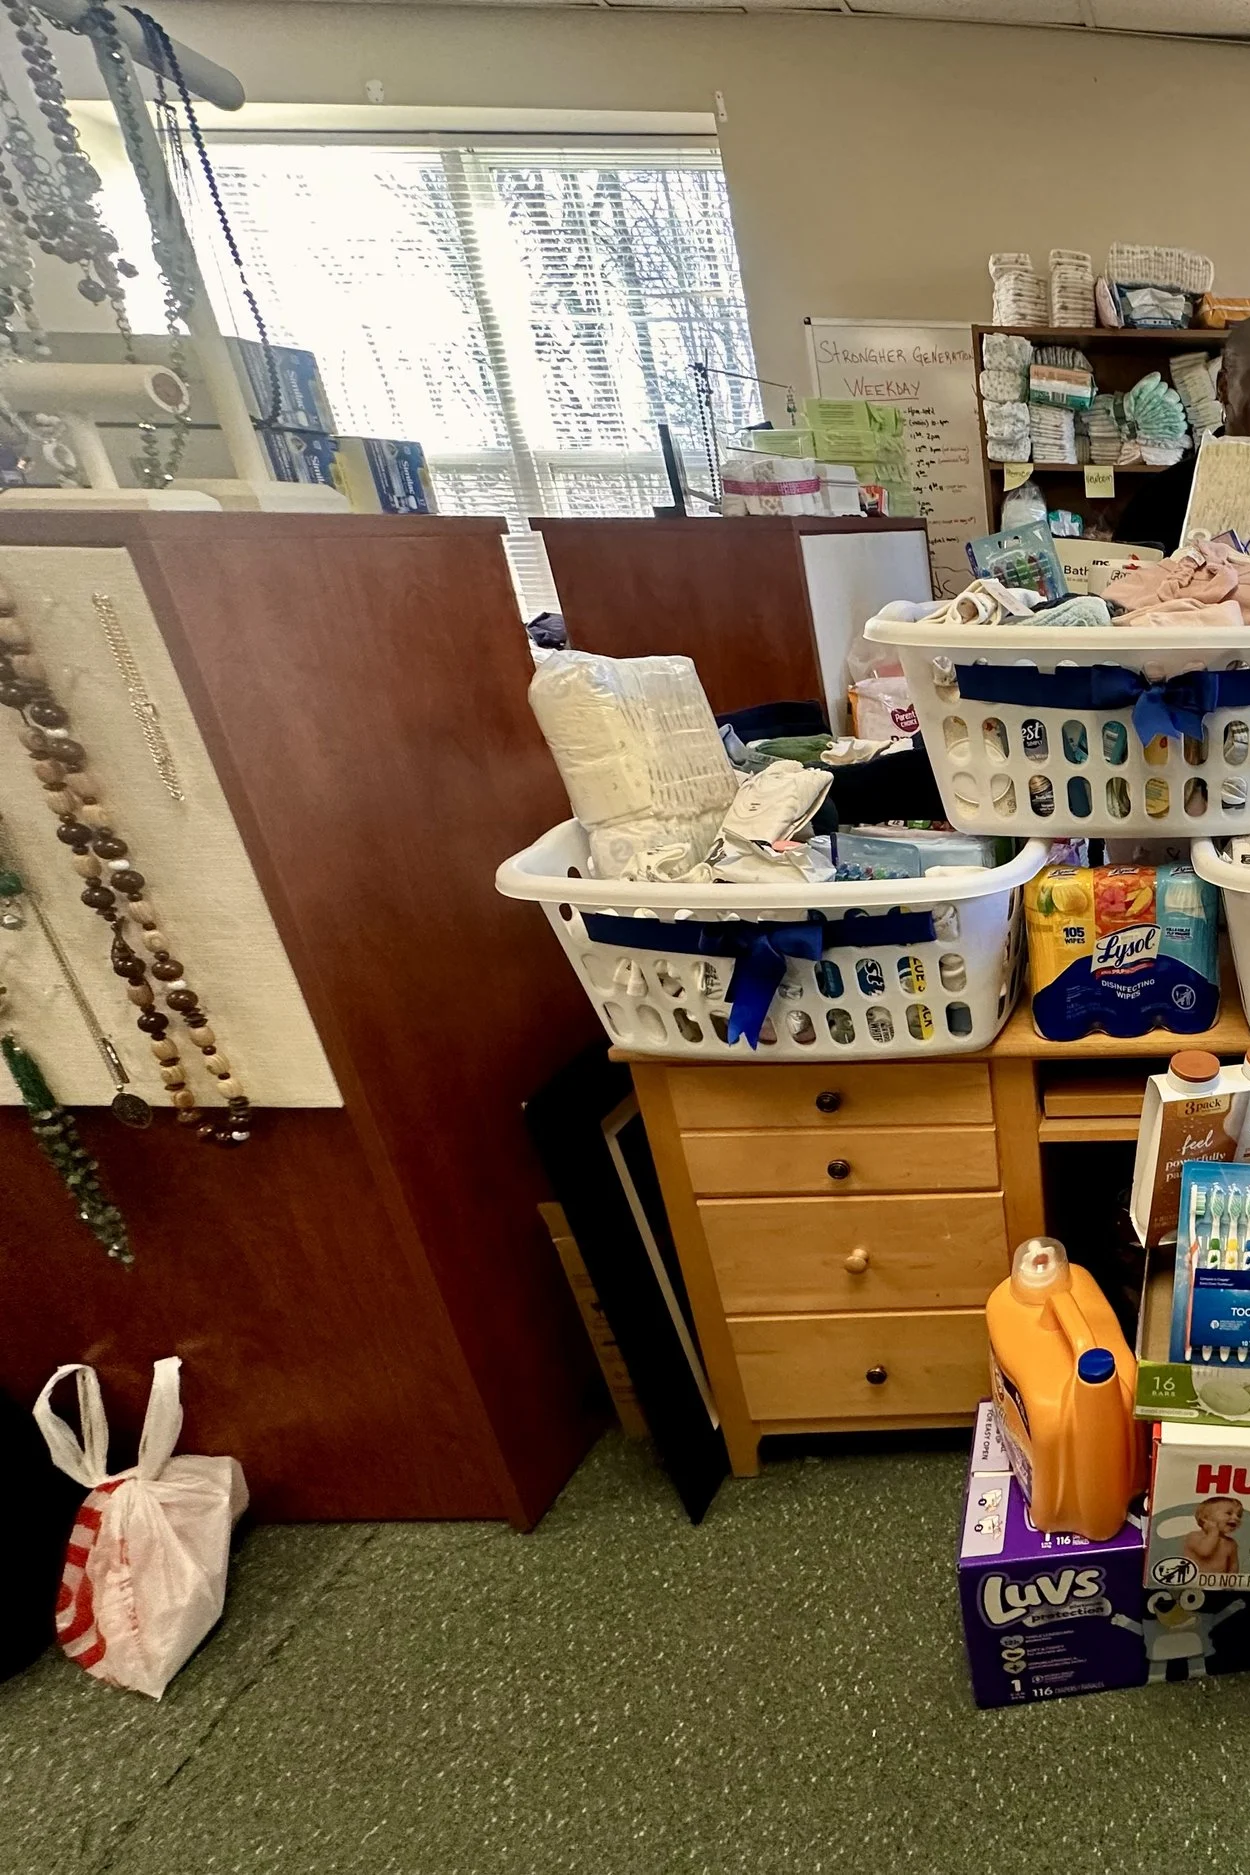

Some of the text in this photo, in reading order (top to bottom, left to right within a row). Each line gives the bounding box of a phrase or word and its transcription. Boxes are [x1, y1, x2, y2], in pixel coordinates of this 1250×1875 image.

[844, 378, 921, 398] WEEKDAY
[311, 455, 326, 485] Simil
[1063, 927, 1085, 938] 105
[1096, 928, 1156, 968] Lysol
[1101, 978, 1156, 993] DISINFECTING
[1116, 990, 1142, 1000] WIPES
[1181, 1129, 1214, 1156] feel
[1152, 1376, 1176, 1391] 16
[981, 1441, 991, 1460] OPEN
[1056, 1536, 1072, 1546] 116
[1199, 1574, 1216, 1587] DO
[1219, 1575, 1245, 1587] NOT
[1031, 1606, 1105, 1624] protection
[1011, 1679, 1022, 1692] 1
[1032, 1687, 1053, 1697] 116
